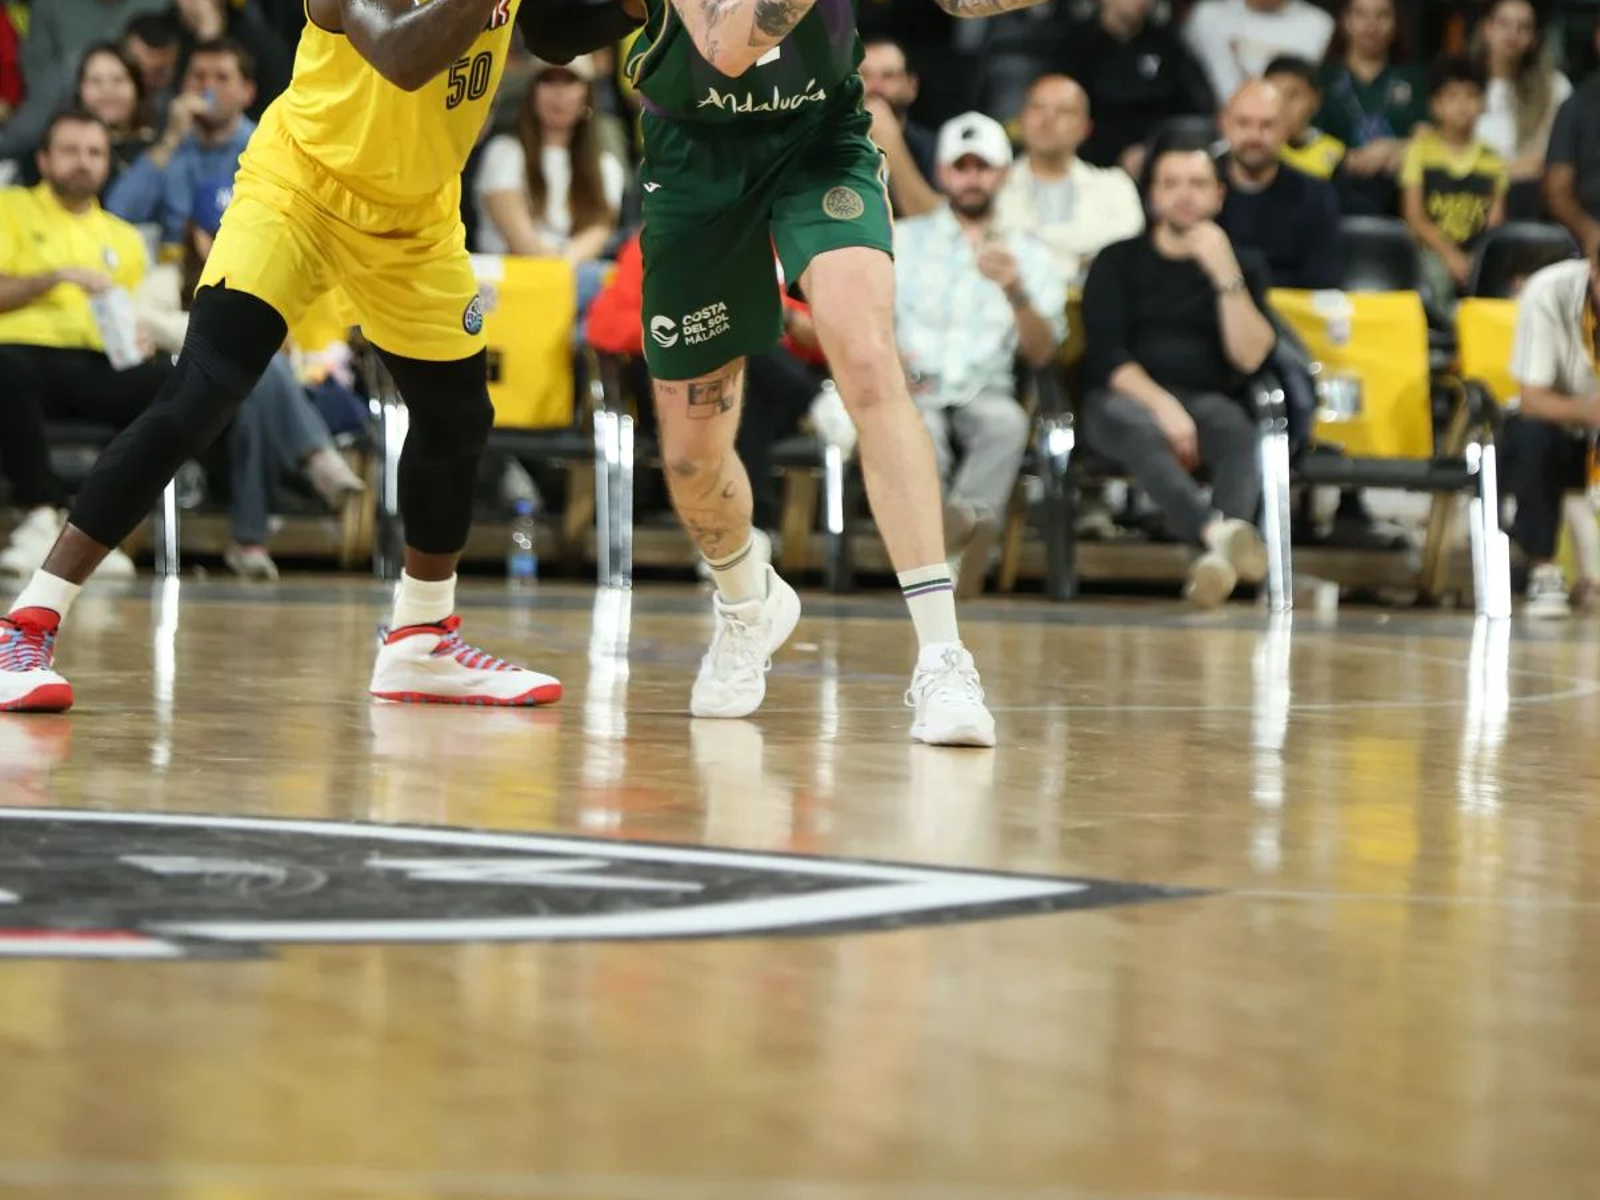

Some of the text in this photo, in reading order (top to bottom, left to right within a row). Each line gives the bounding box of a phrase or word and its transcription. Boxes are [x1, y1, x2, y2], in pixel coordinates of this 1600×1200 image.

[446, 51, 492, 110] 50
[682, 302, 727, 326] COSTA
[683, 313, 729, 336] DEL SOL
[685, 322, 730, 345] MÁLAGA
